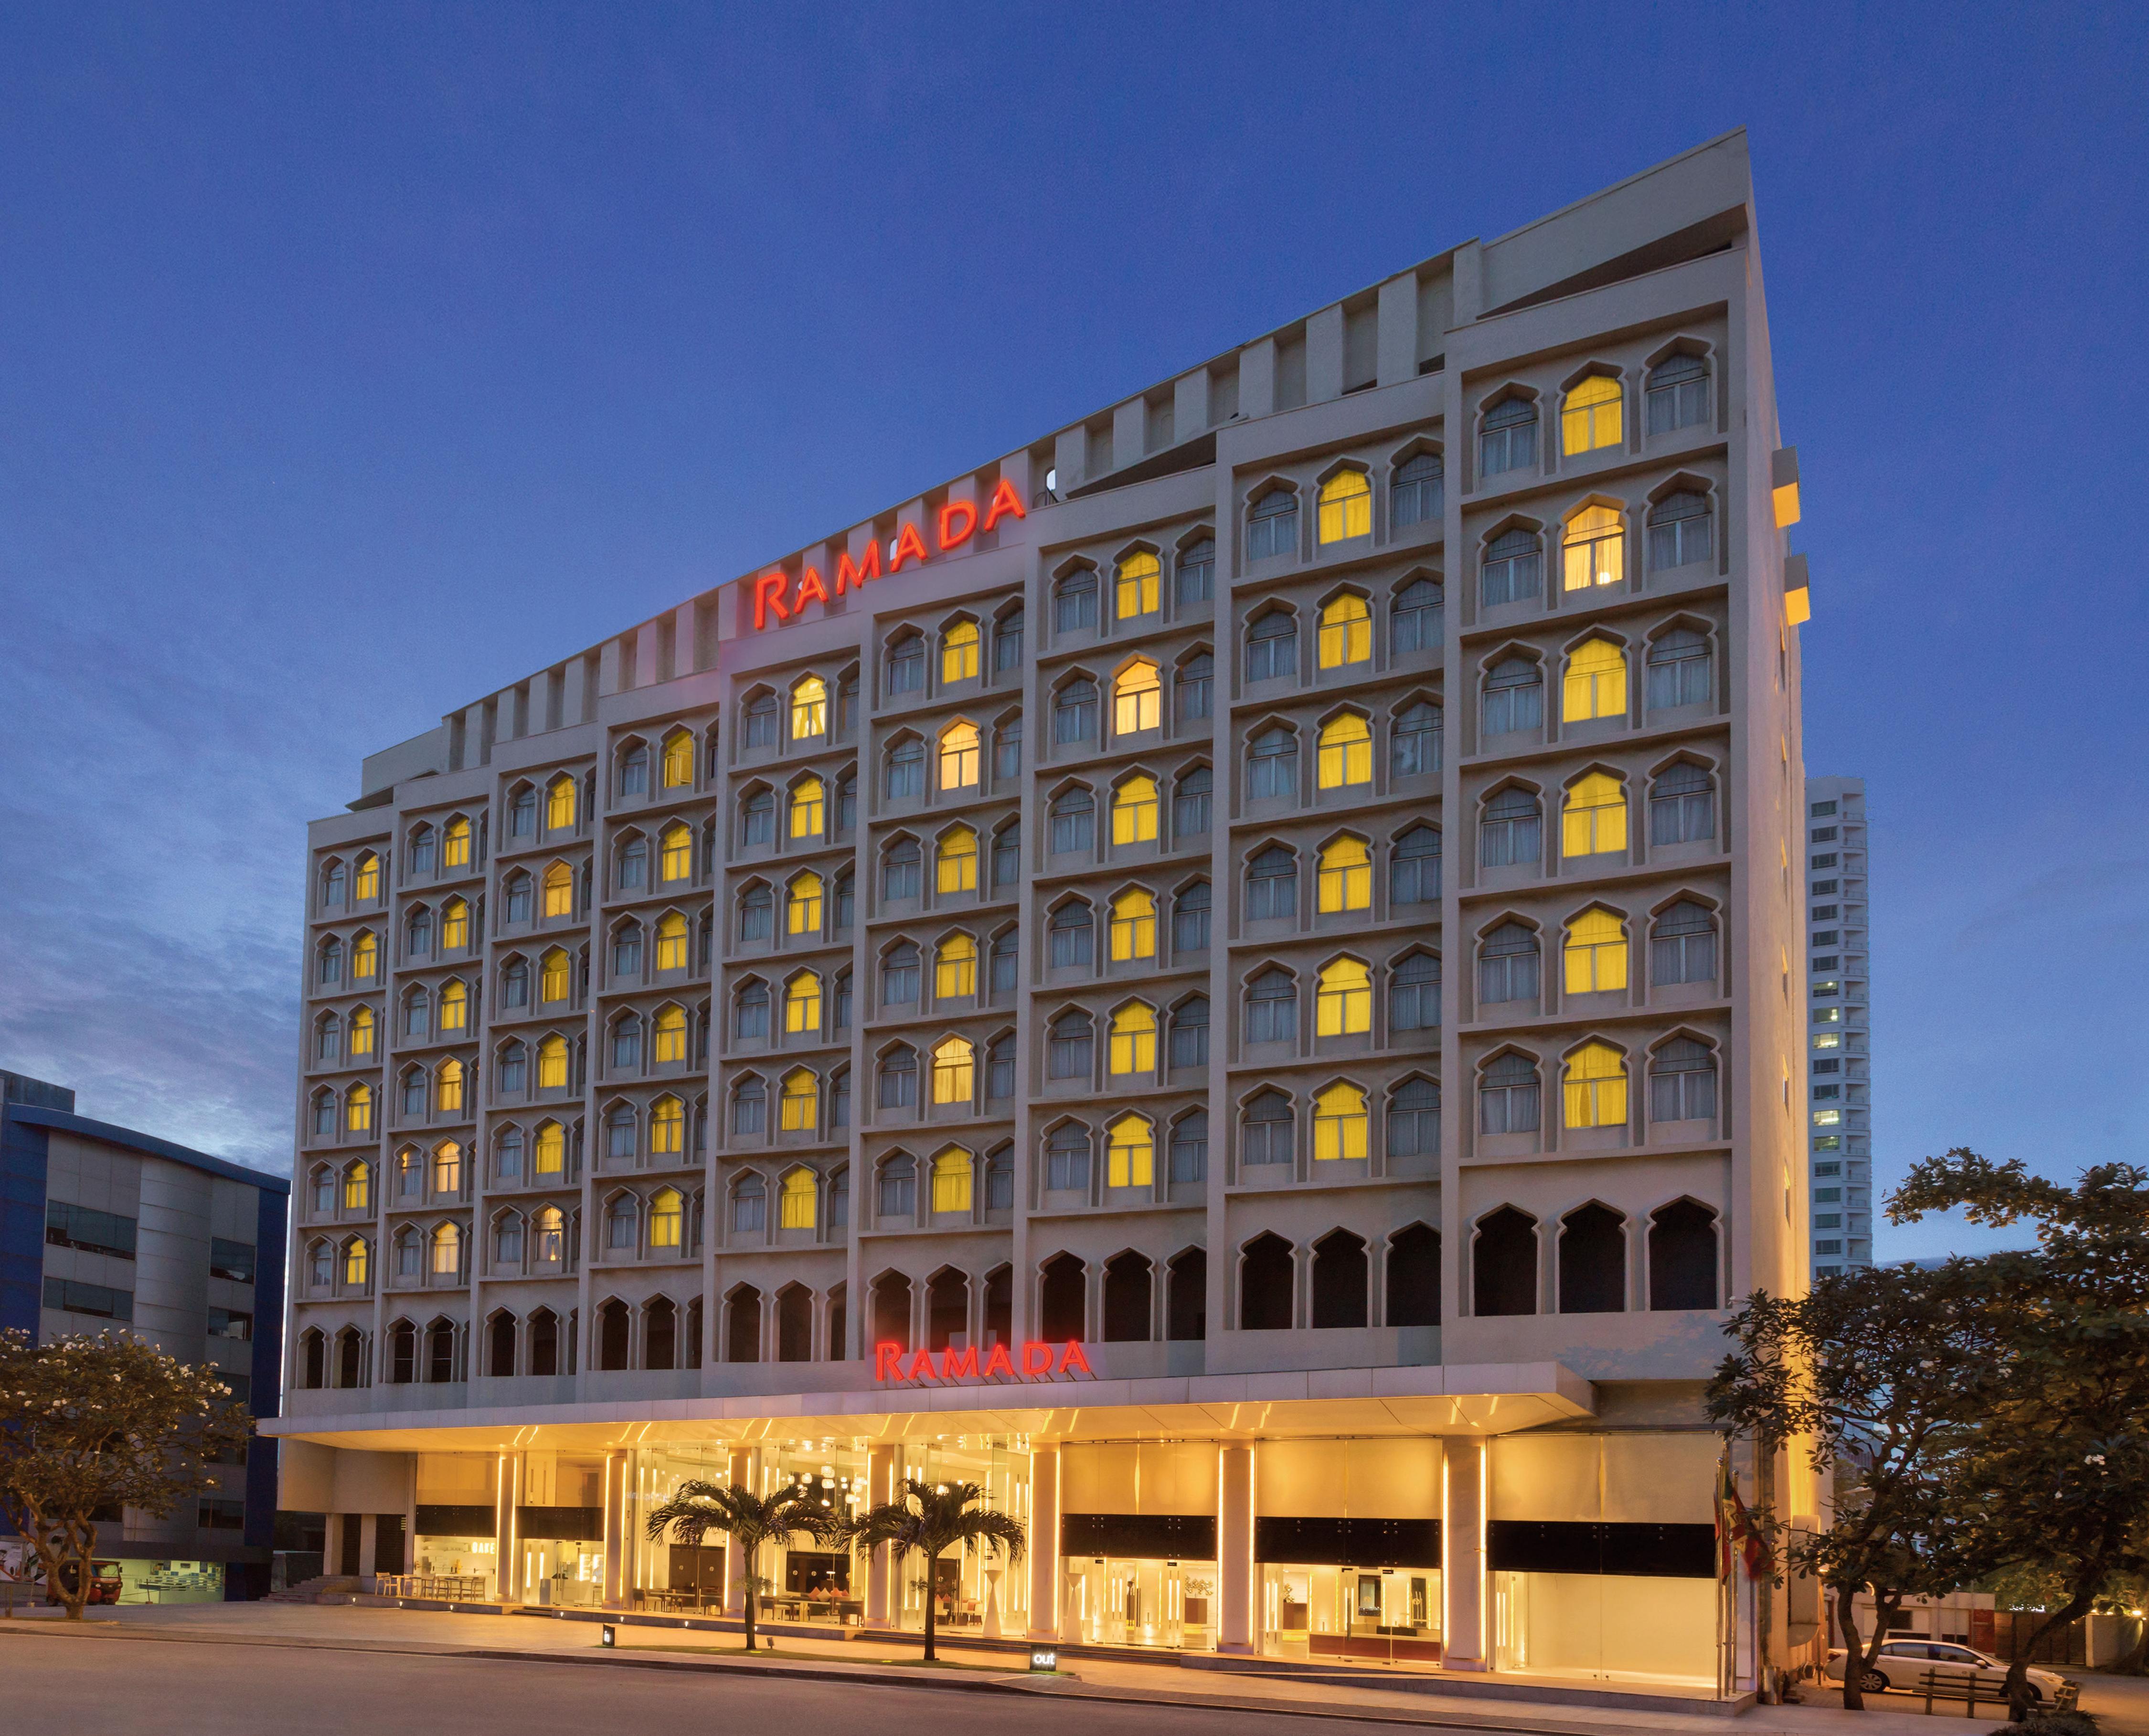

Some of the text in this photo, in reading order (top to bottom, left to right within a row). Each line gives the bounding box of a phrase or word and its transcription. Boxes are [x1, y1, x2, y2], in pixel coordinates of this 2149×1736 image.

[754, 481, 1025, 630] RAMADA
[876, 1341, 1090, 1381] RAMADA
[604, 1630, 610, 1642] in
[1034, 1653, 1055, 1665] out
